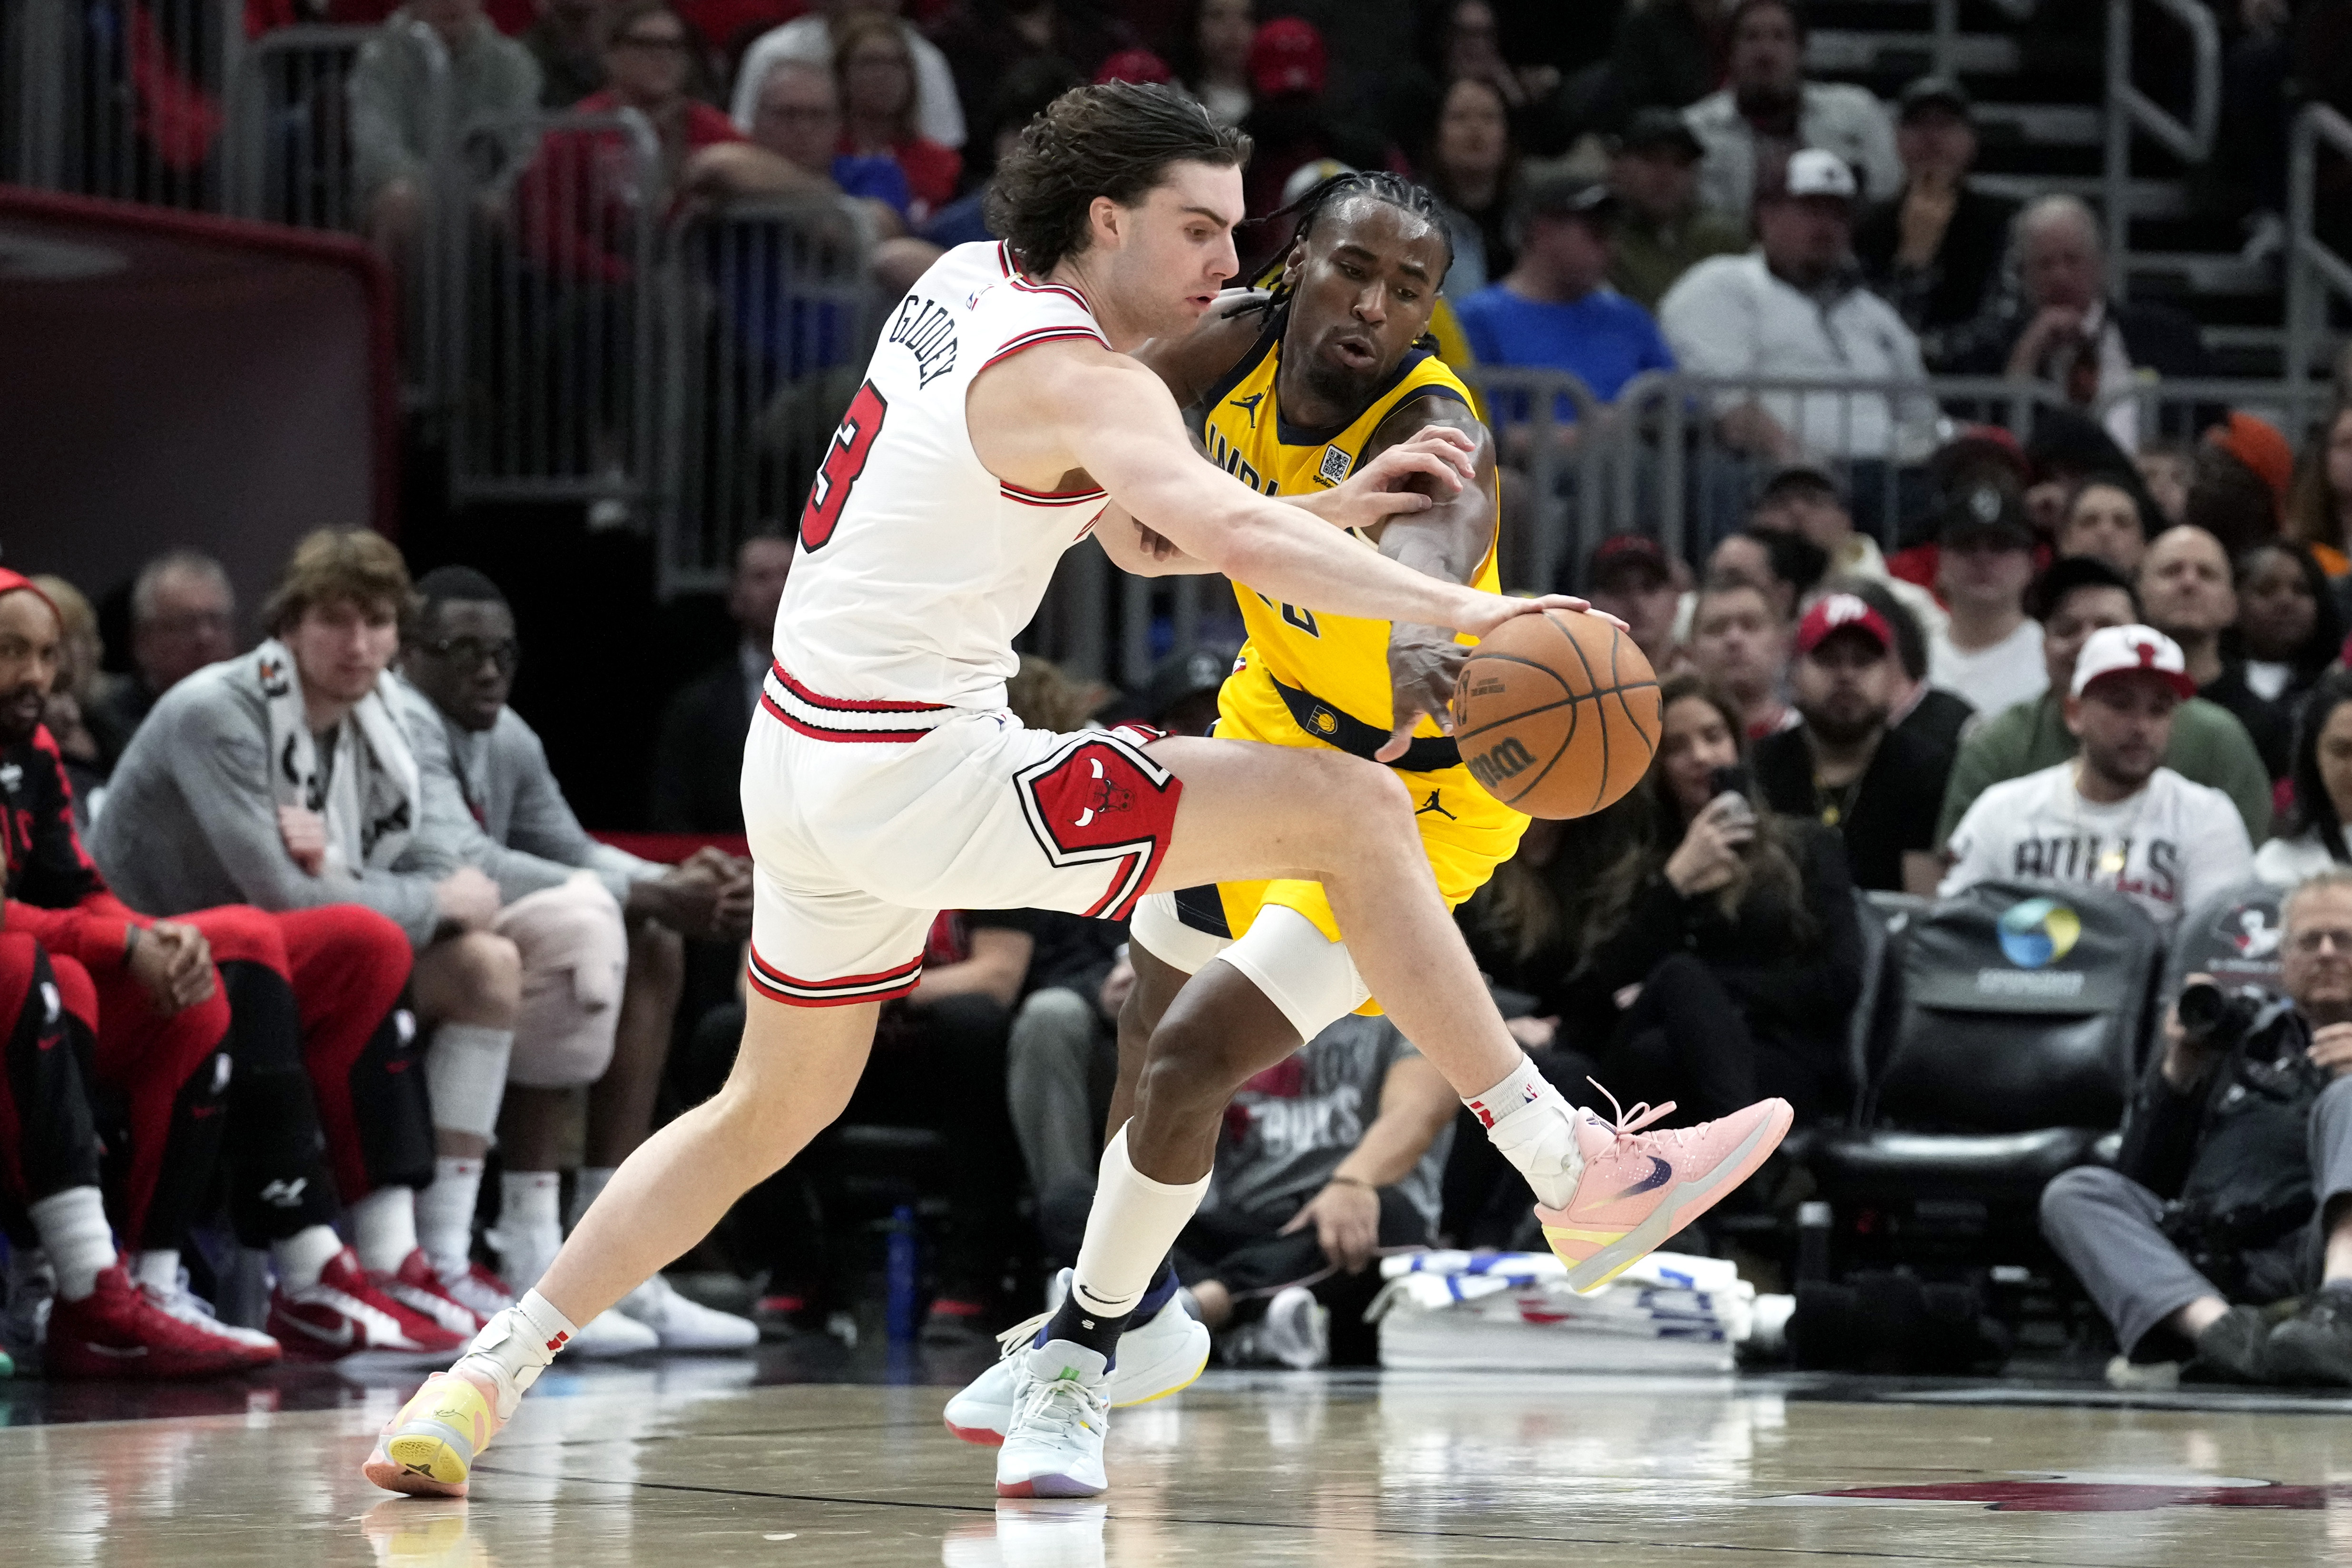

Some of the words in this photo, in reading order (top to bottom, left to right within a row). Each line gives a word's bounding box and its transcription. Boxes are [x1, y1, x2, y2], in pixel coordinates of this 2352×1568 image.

[889, 294, 958, 390] GIDDEY
[800, 378, 888, 554] 3
[1313, 475, 1334, 488] spoke
